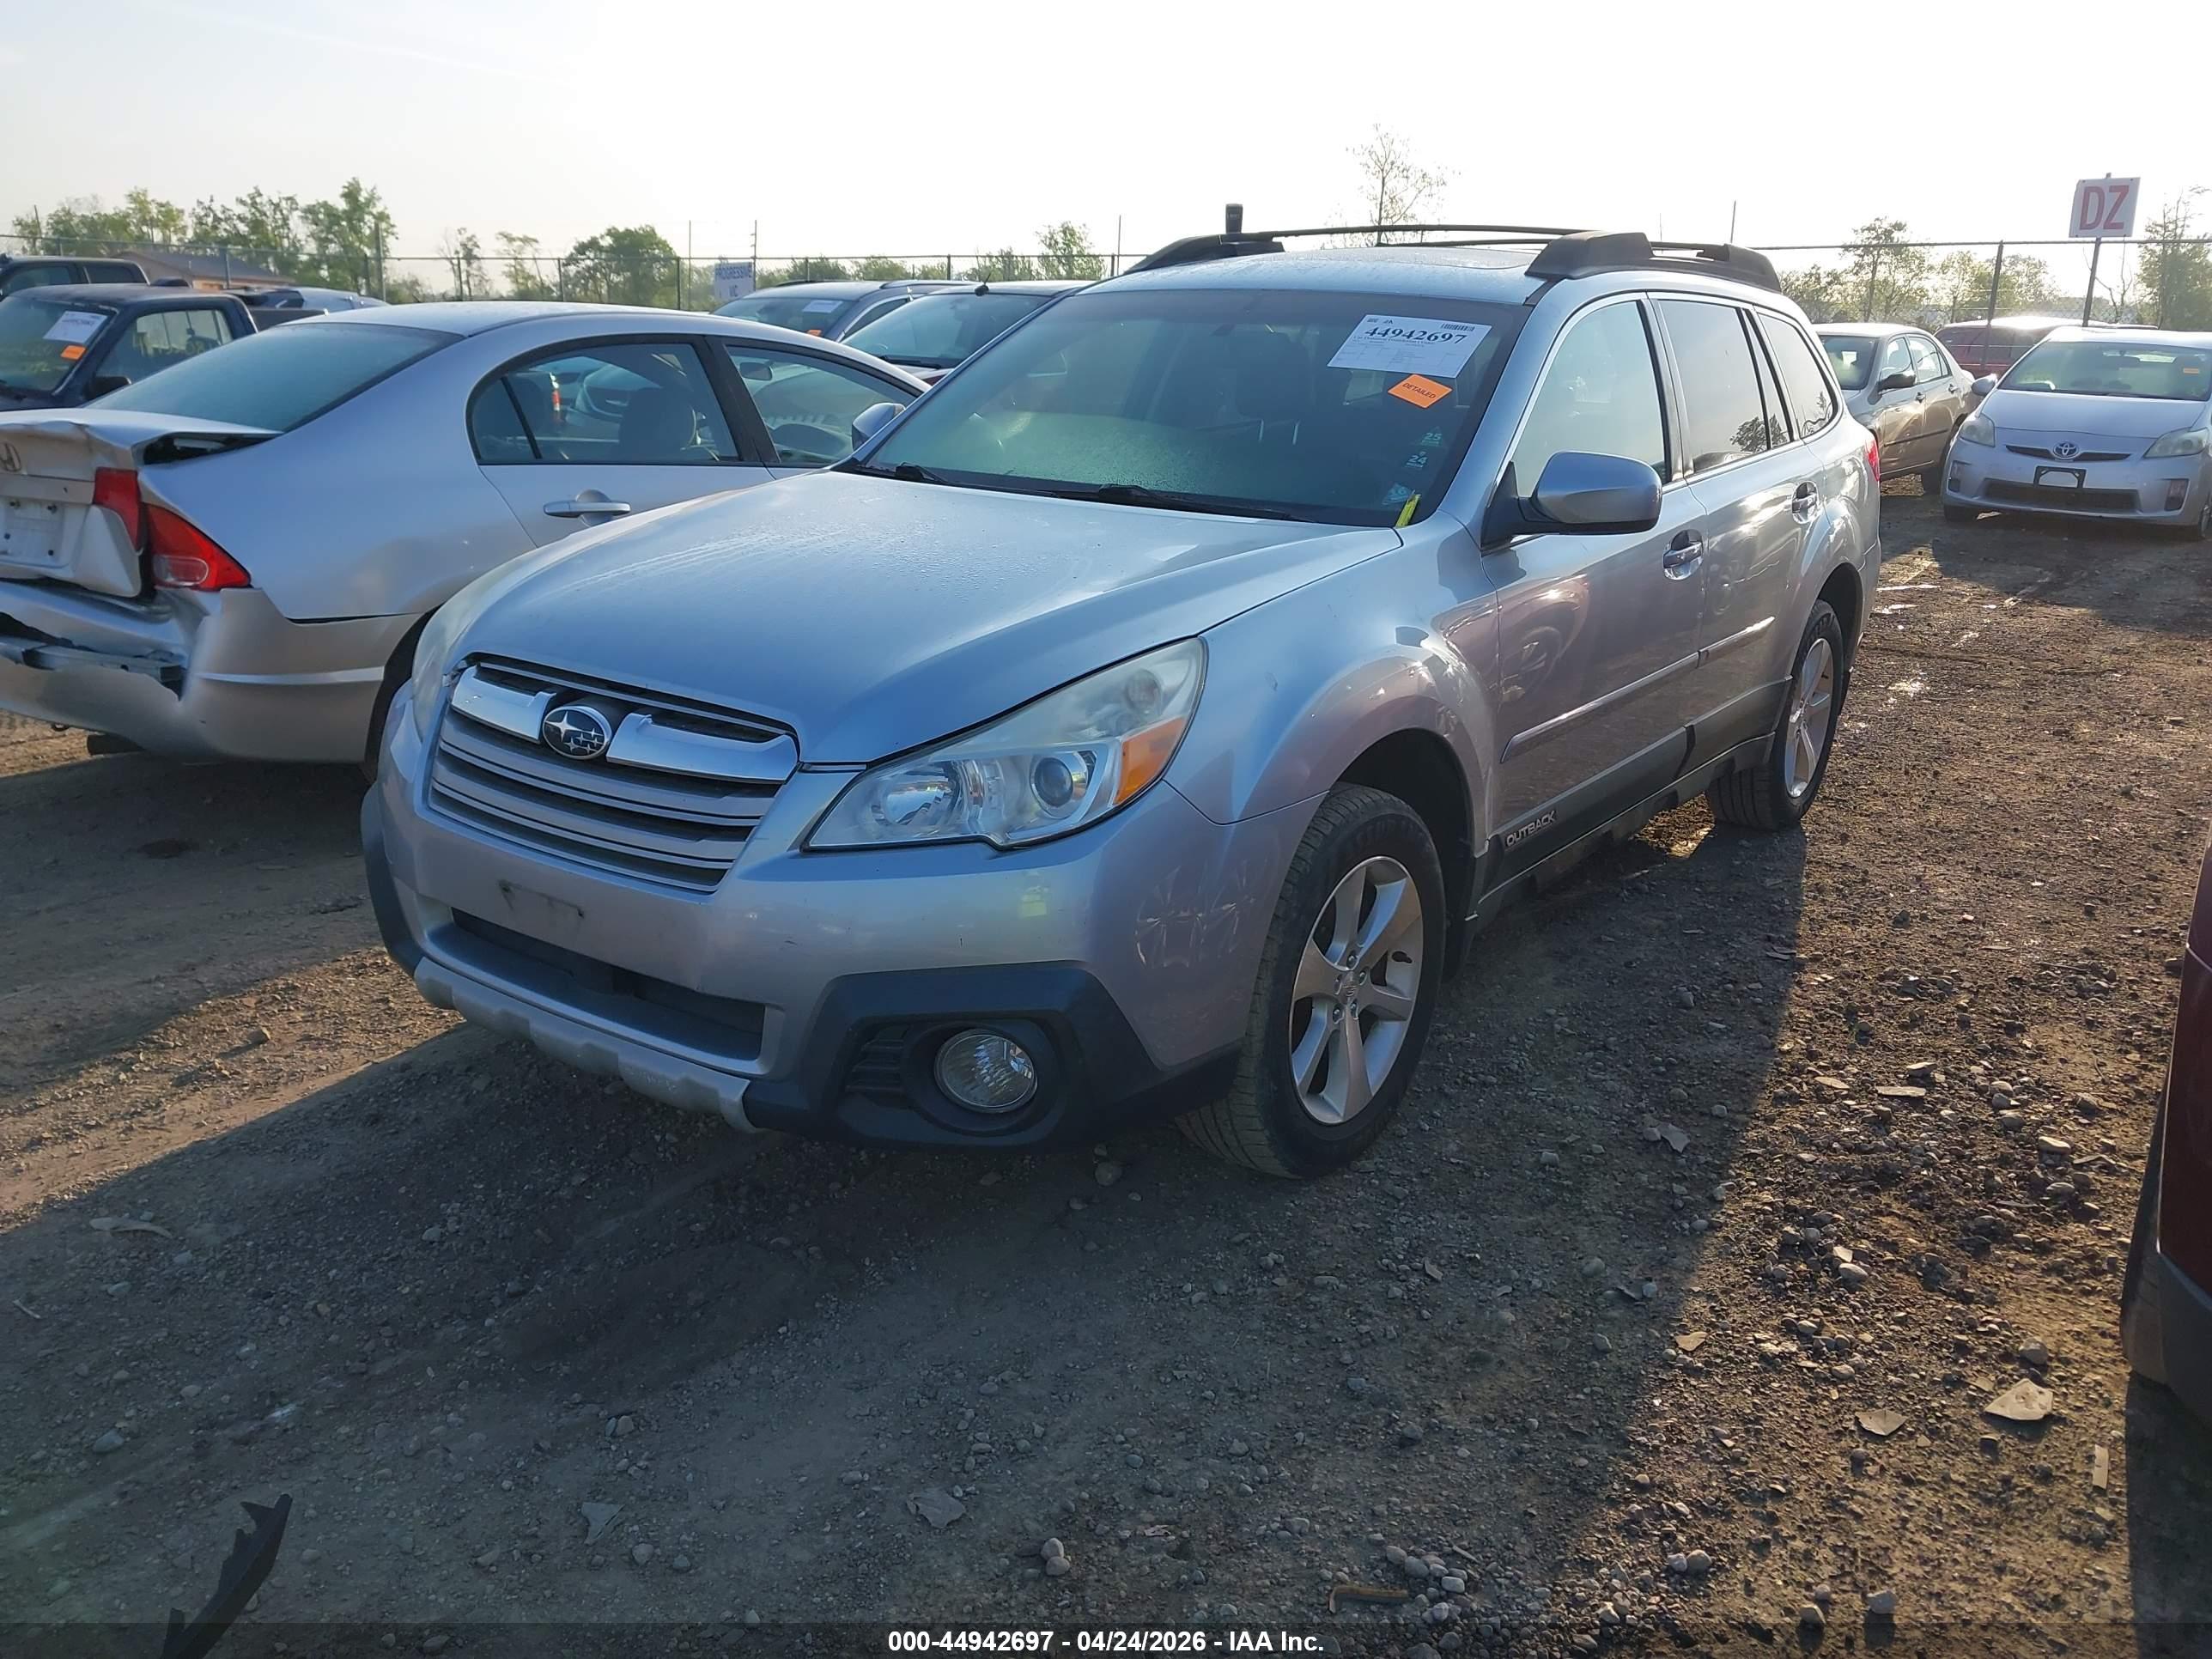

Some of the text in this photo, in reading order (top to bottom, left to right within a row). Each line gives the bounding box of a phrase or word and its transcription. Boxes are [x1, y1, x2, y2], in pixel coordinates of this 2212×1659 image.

[2079, 185, 2130, 230] DZ
[1365, 326, 1468, 344] 44942697
[1401, 382, 1437, 398] DETAILED
[1424, 432, 1443, 441] 25
[1408, 454, 1428, 465] 24
[1506, 810, 1556, 848] OUTBACK
